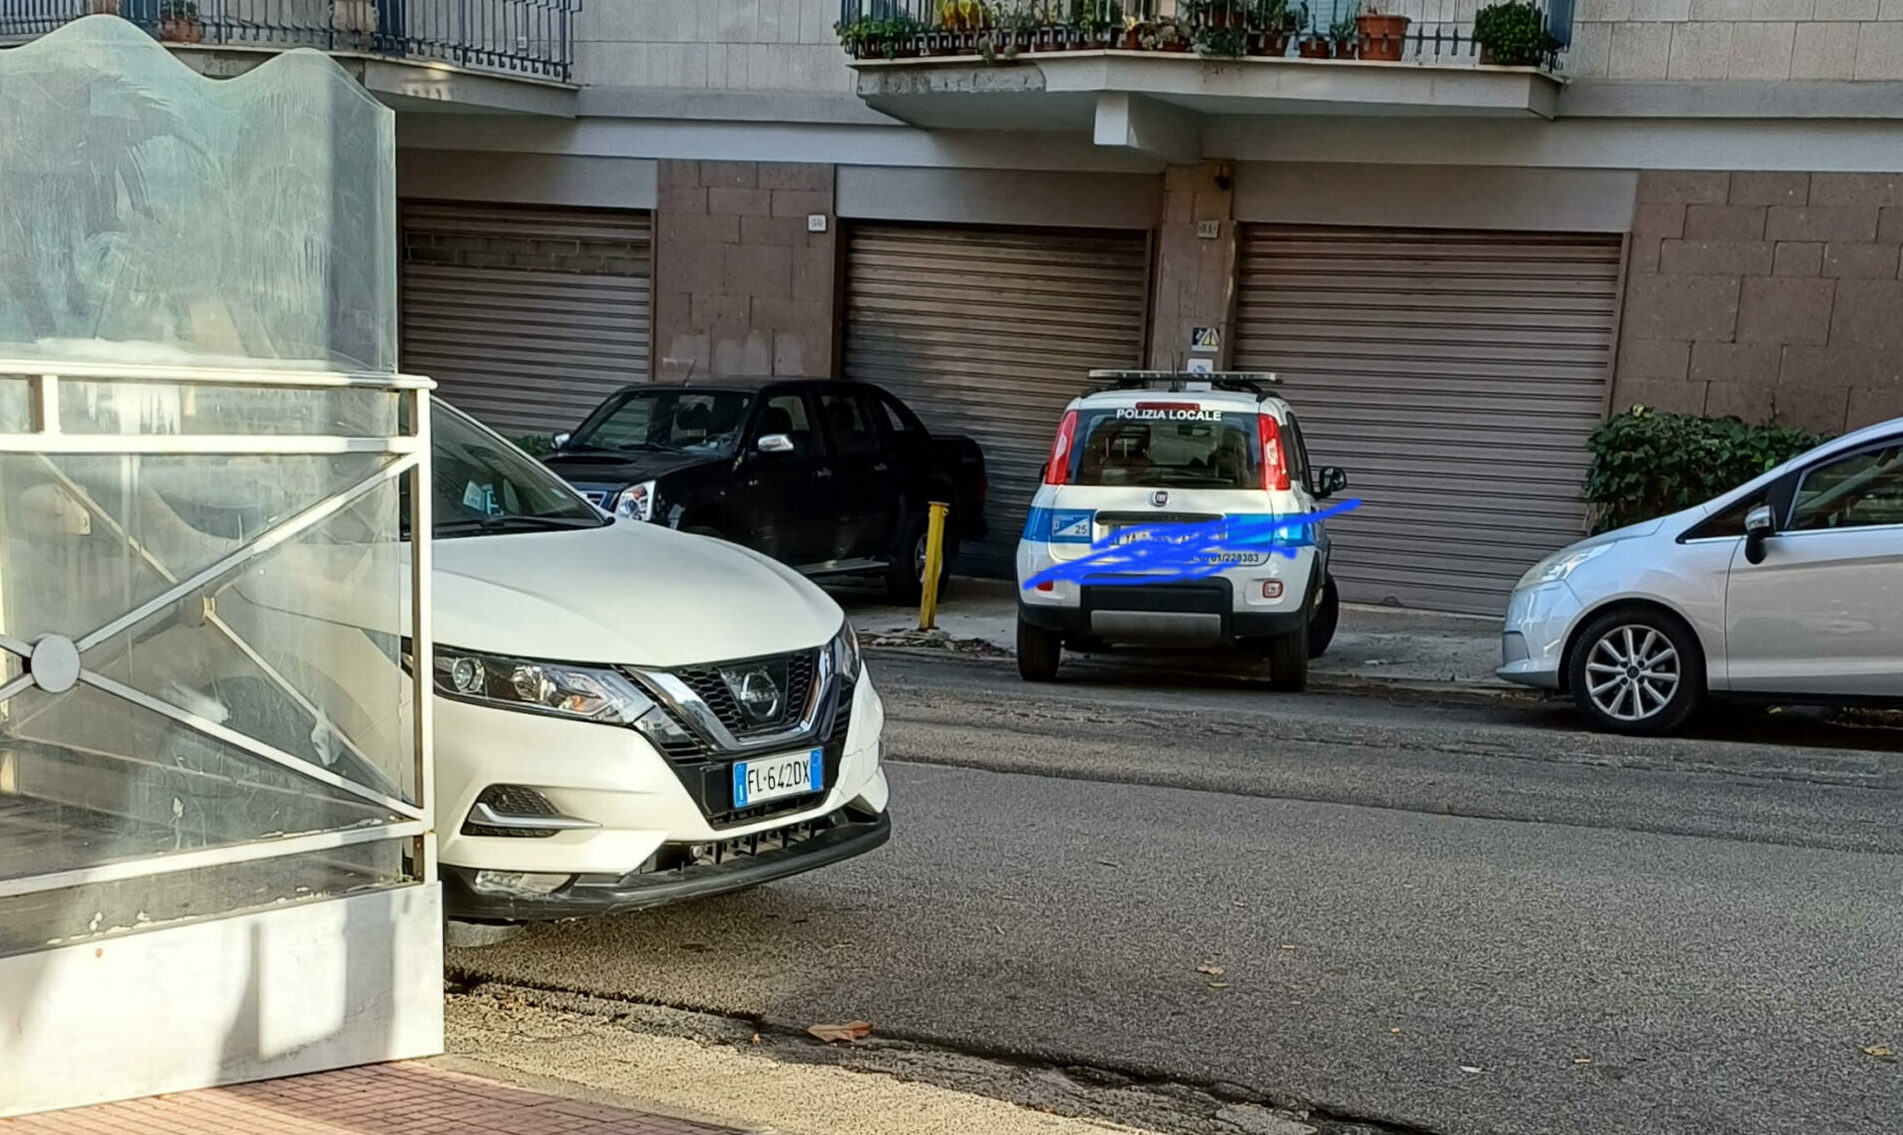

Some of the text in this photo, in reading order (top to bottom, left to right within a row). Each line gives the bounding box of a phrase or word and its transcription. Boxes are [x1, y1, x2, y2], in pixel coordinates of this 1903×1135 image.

[1116, 409, 1222, 421] POLIZIA LOCALE
[1075, 524, 1088, 534] 25
